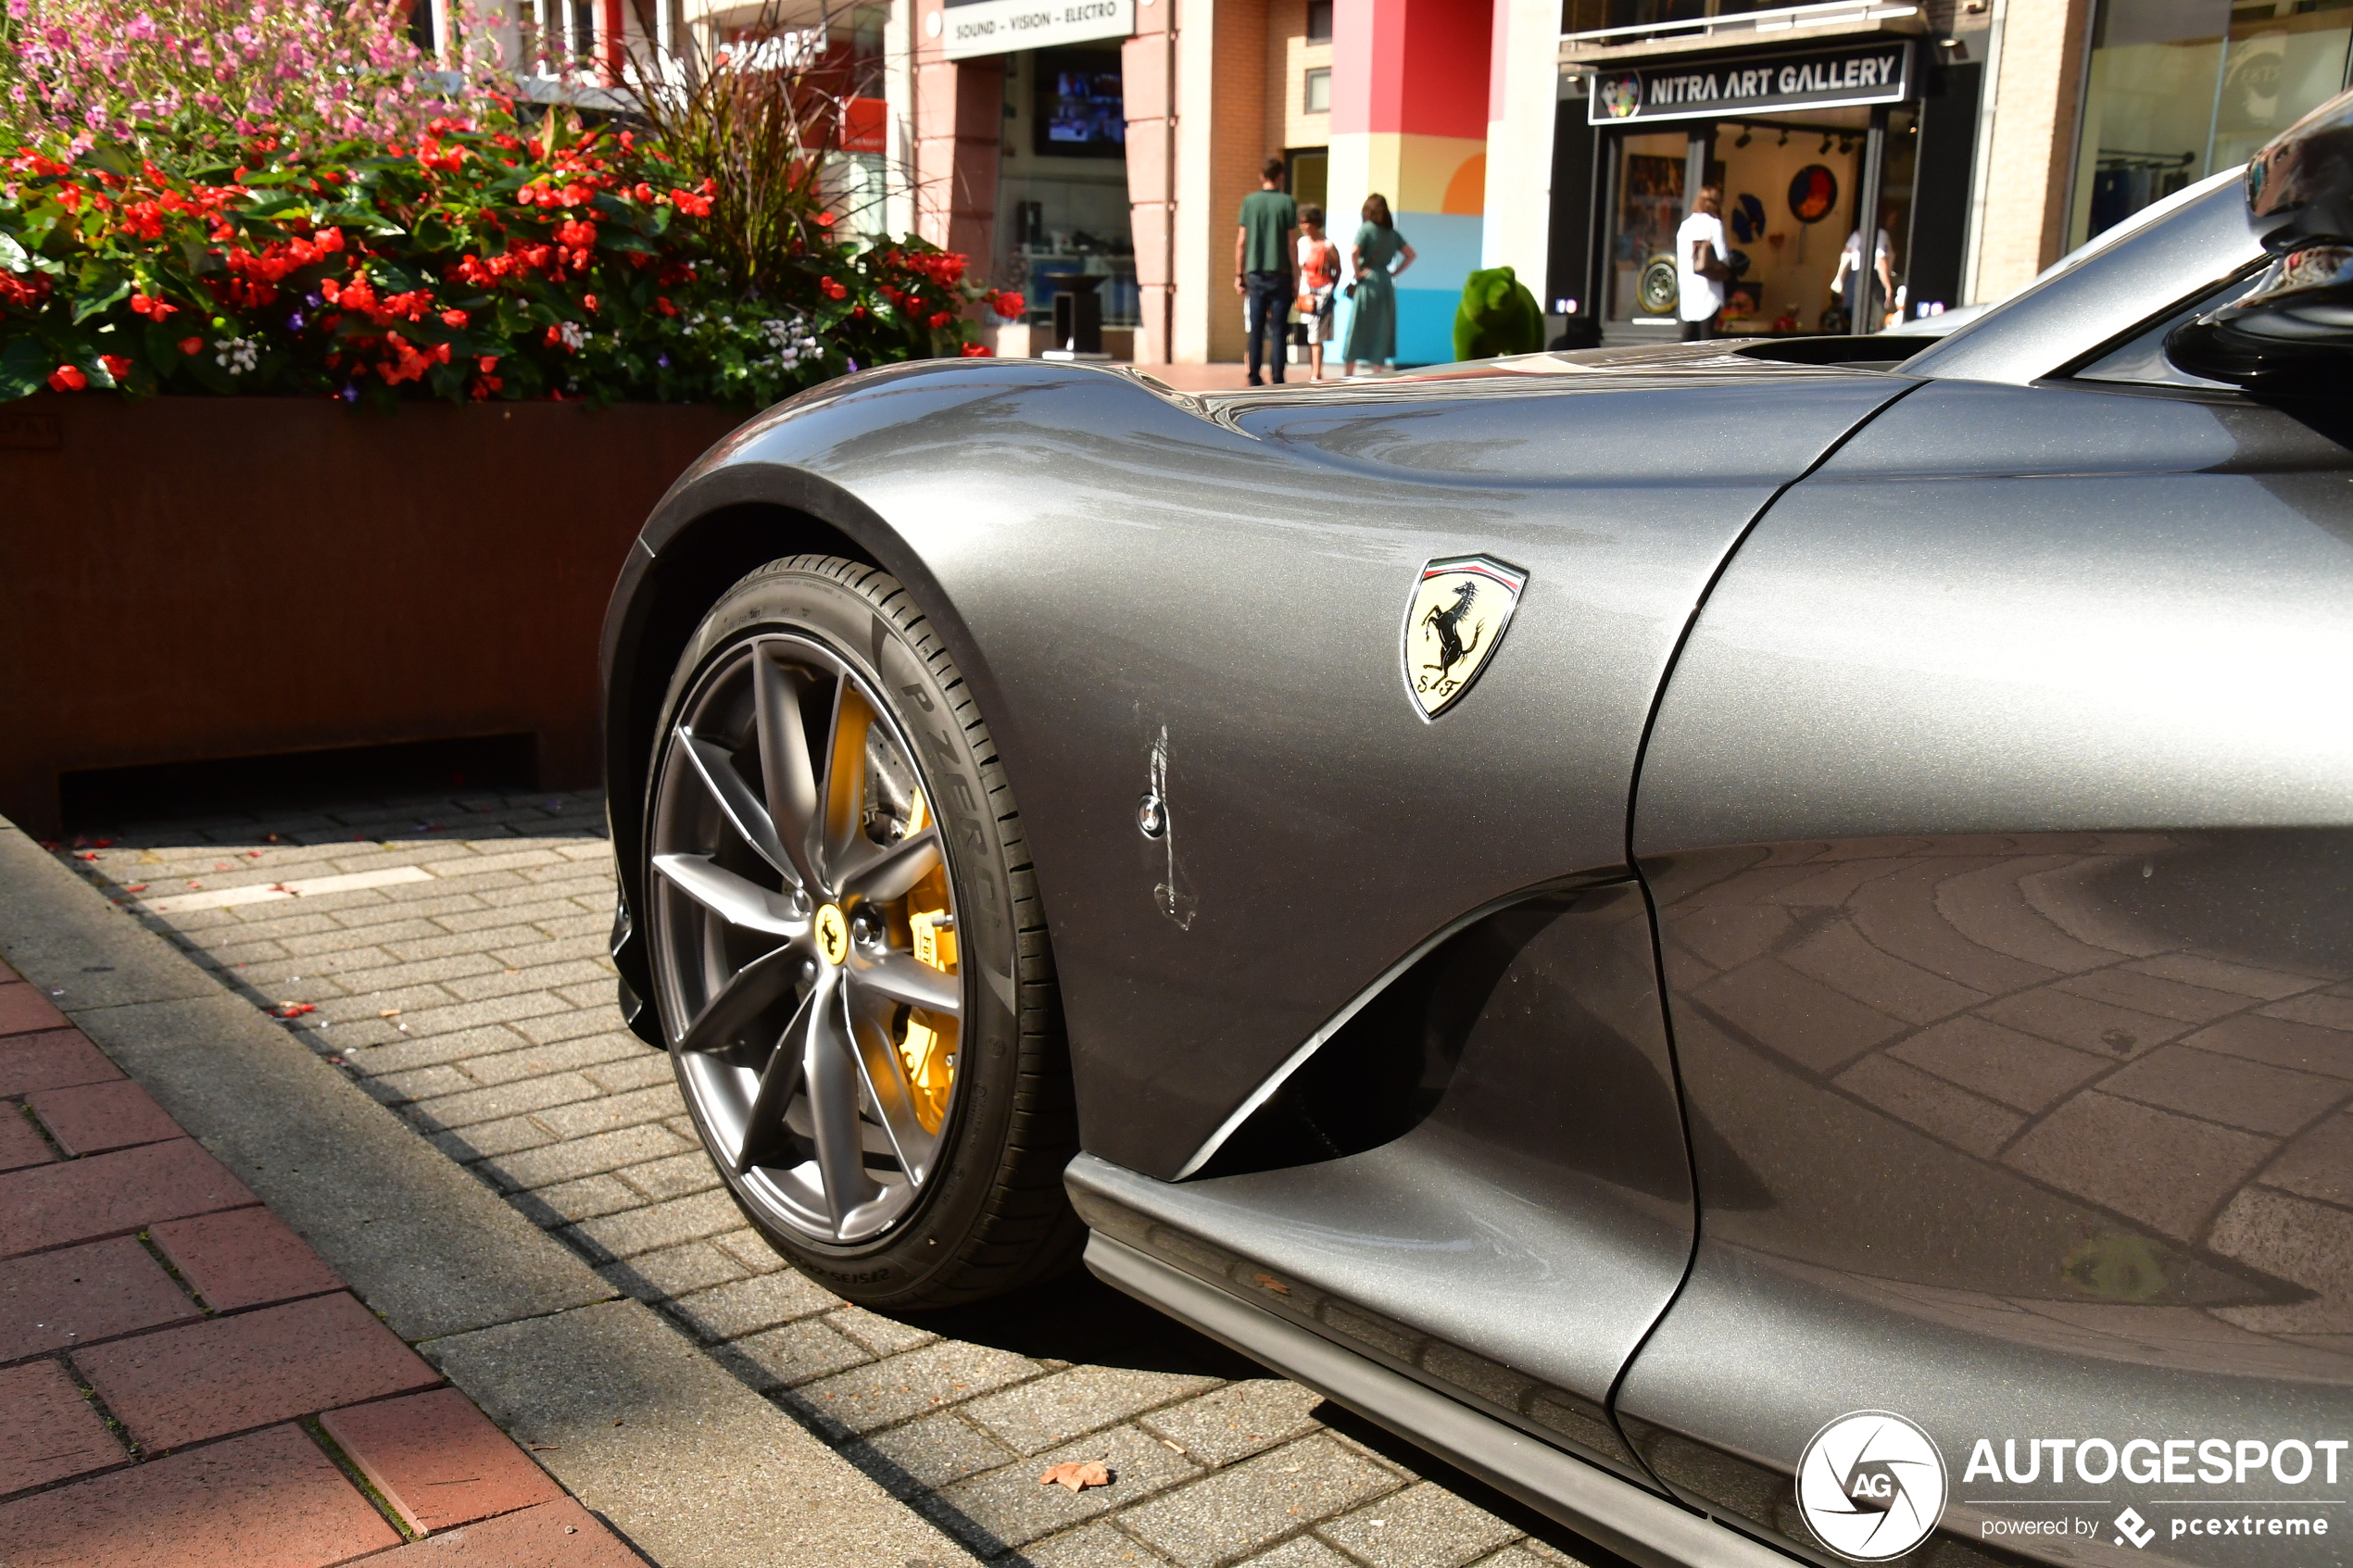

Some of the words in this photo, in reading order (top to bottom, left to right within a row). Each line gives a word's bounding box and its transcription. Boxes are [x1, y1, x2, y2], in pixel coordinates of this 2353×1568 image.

[955, 20, 996, 40] SOUND
[1009, 12, 1051, 31] VISION
[1064, 1, 1117, 23] ELECTRO
[1649, 73, 1719, 106] NITRA
[1723, 67, 1774, 98] ART
[1778, 55, 1896, 94] GALLERY
[1417, 674, 1428, 694] S
[1439, 679, 1462, 697] F
